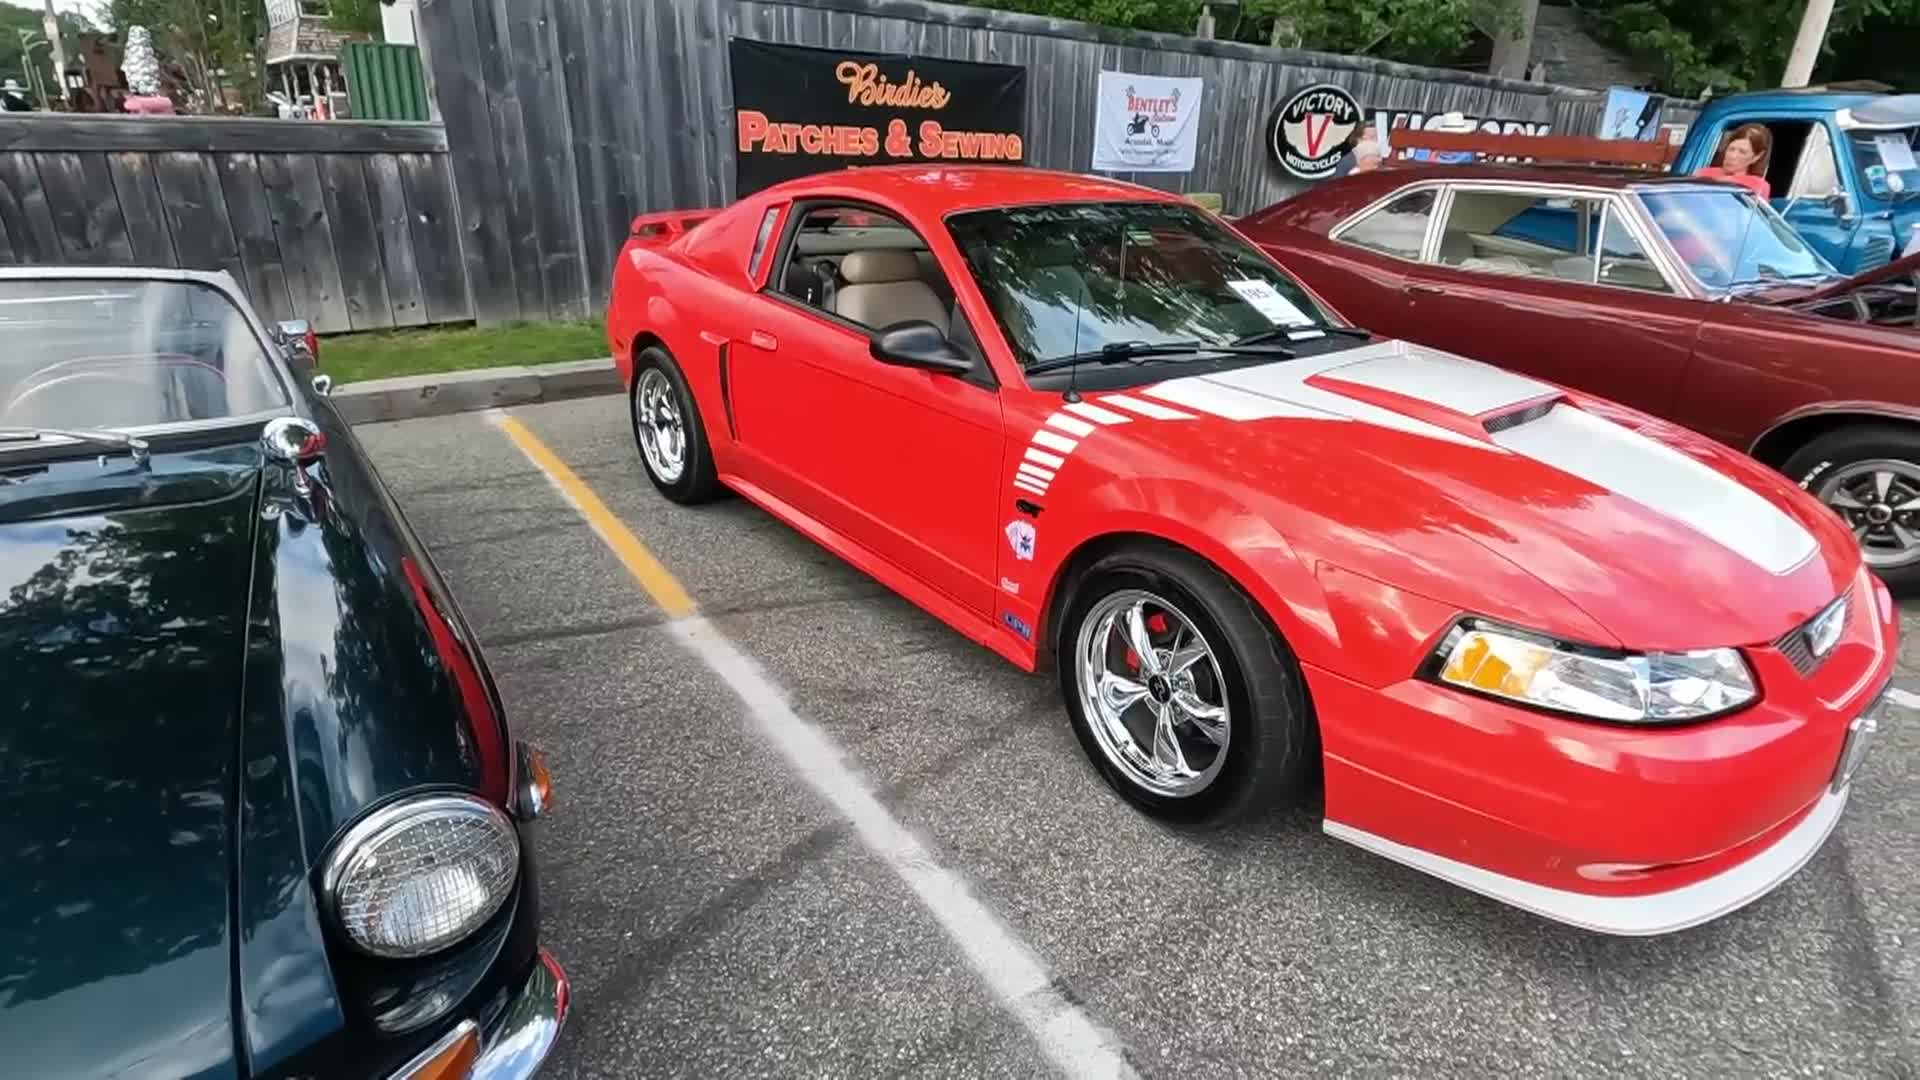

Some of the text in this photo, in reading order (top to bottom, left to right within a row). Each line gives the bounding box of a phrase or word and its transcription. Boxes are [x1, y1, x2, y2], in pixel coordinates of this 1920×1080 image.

[1292, 93, 1354, 121] VICTORY
[737, 110, 1022, 160] PATCHES & SEWING
[1285, 151, 1342, 171] MOTORCYCLES
